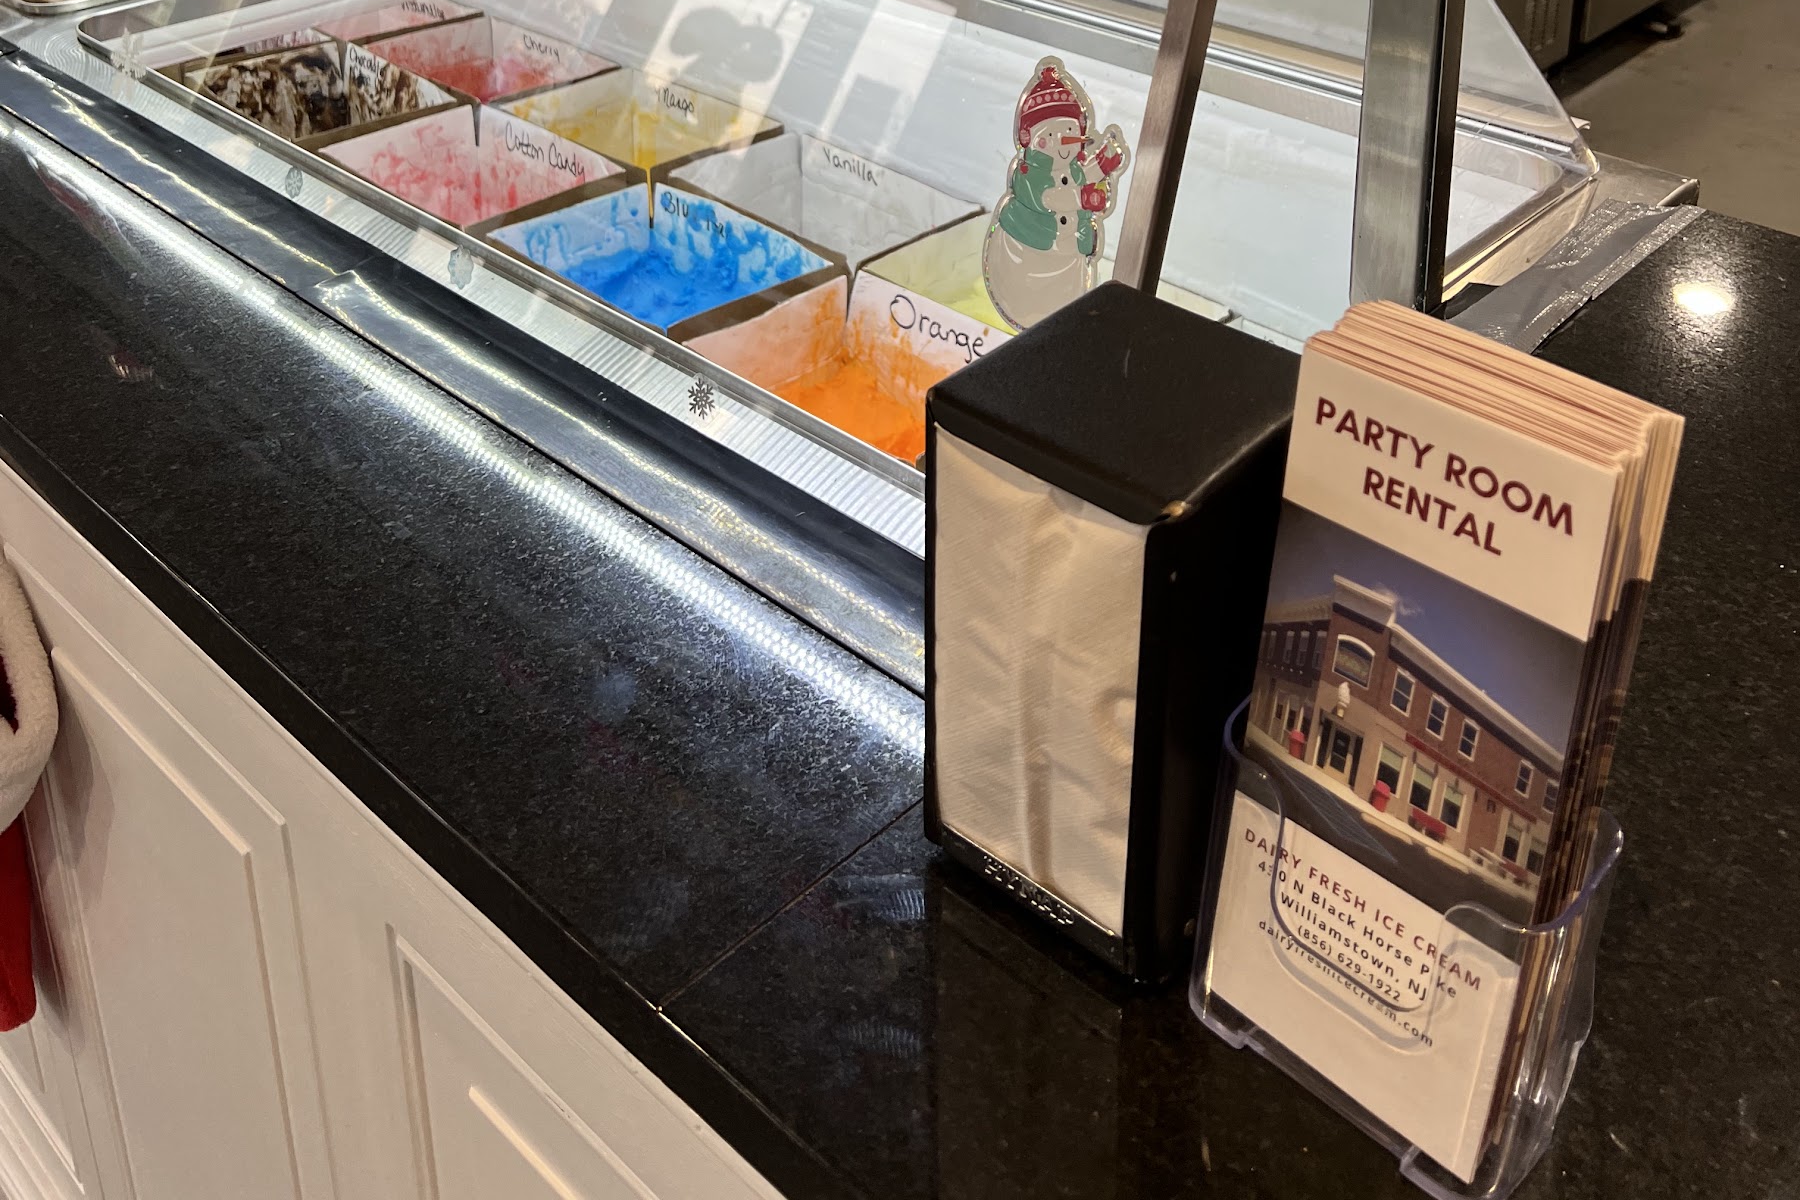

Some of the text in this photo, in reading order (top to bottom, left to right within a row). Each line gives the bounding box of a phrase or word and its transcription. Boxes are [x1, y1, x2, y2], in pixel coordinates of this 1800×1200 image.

[505, 122, 586, 182] Cotton Candy
[822, 146, 879, 187] Vanilla
[662, 191, 689, 217] Blu
[888, 294, 988, 364] Orange
[1315, 396, 1574, 537] PARTY ROOM
[1363, 466, 1502, 557] RENTAL
[1245, 828, 1482, 991] DAIRY FRESH ICE CREAM
[1280, 891, 1427, 1001] Williamstown, NJ
[1293, 879, 1305, 897] N
[1311, 891, 1357, 929] Black
[1362, 925, 1413, 967] Horse
[1420, 963, 1457, 999] Pke
[1297, 924, 1401, 1003] (856) 629-1922
